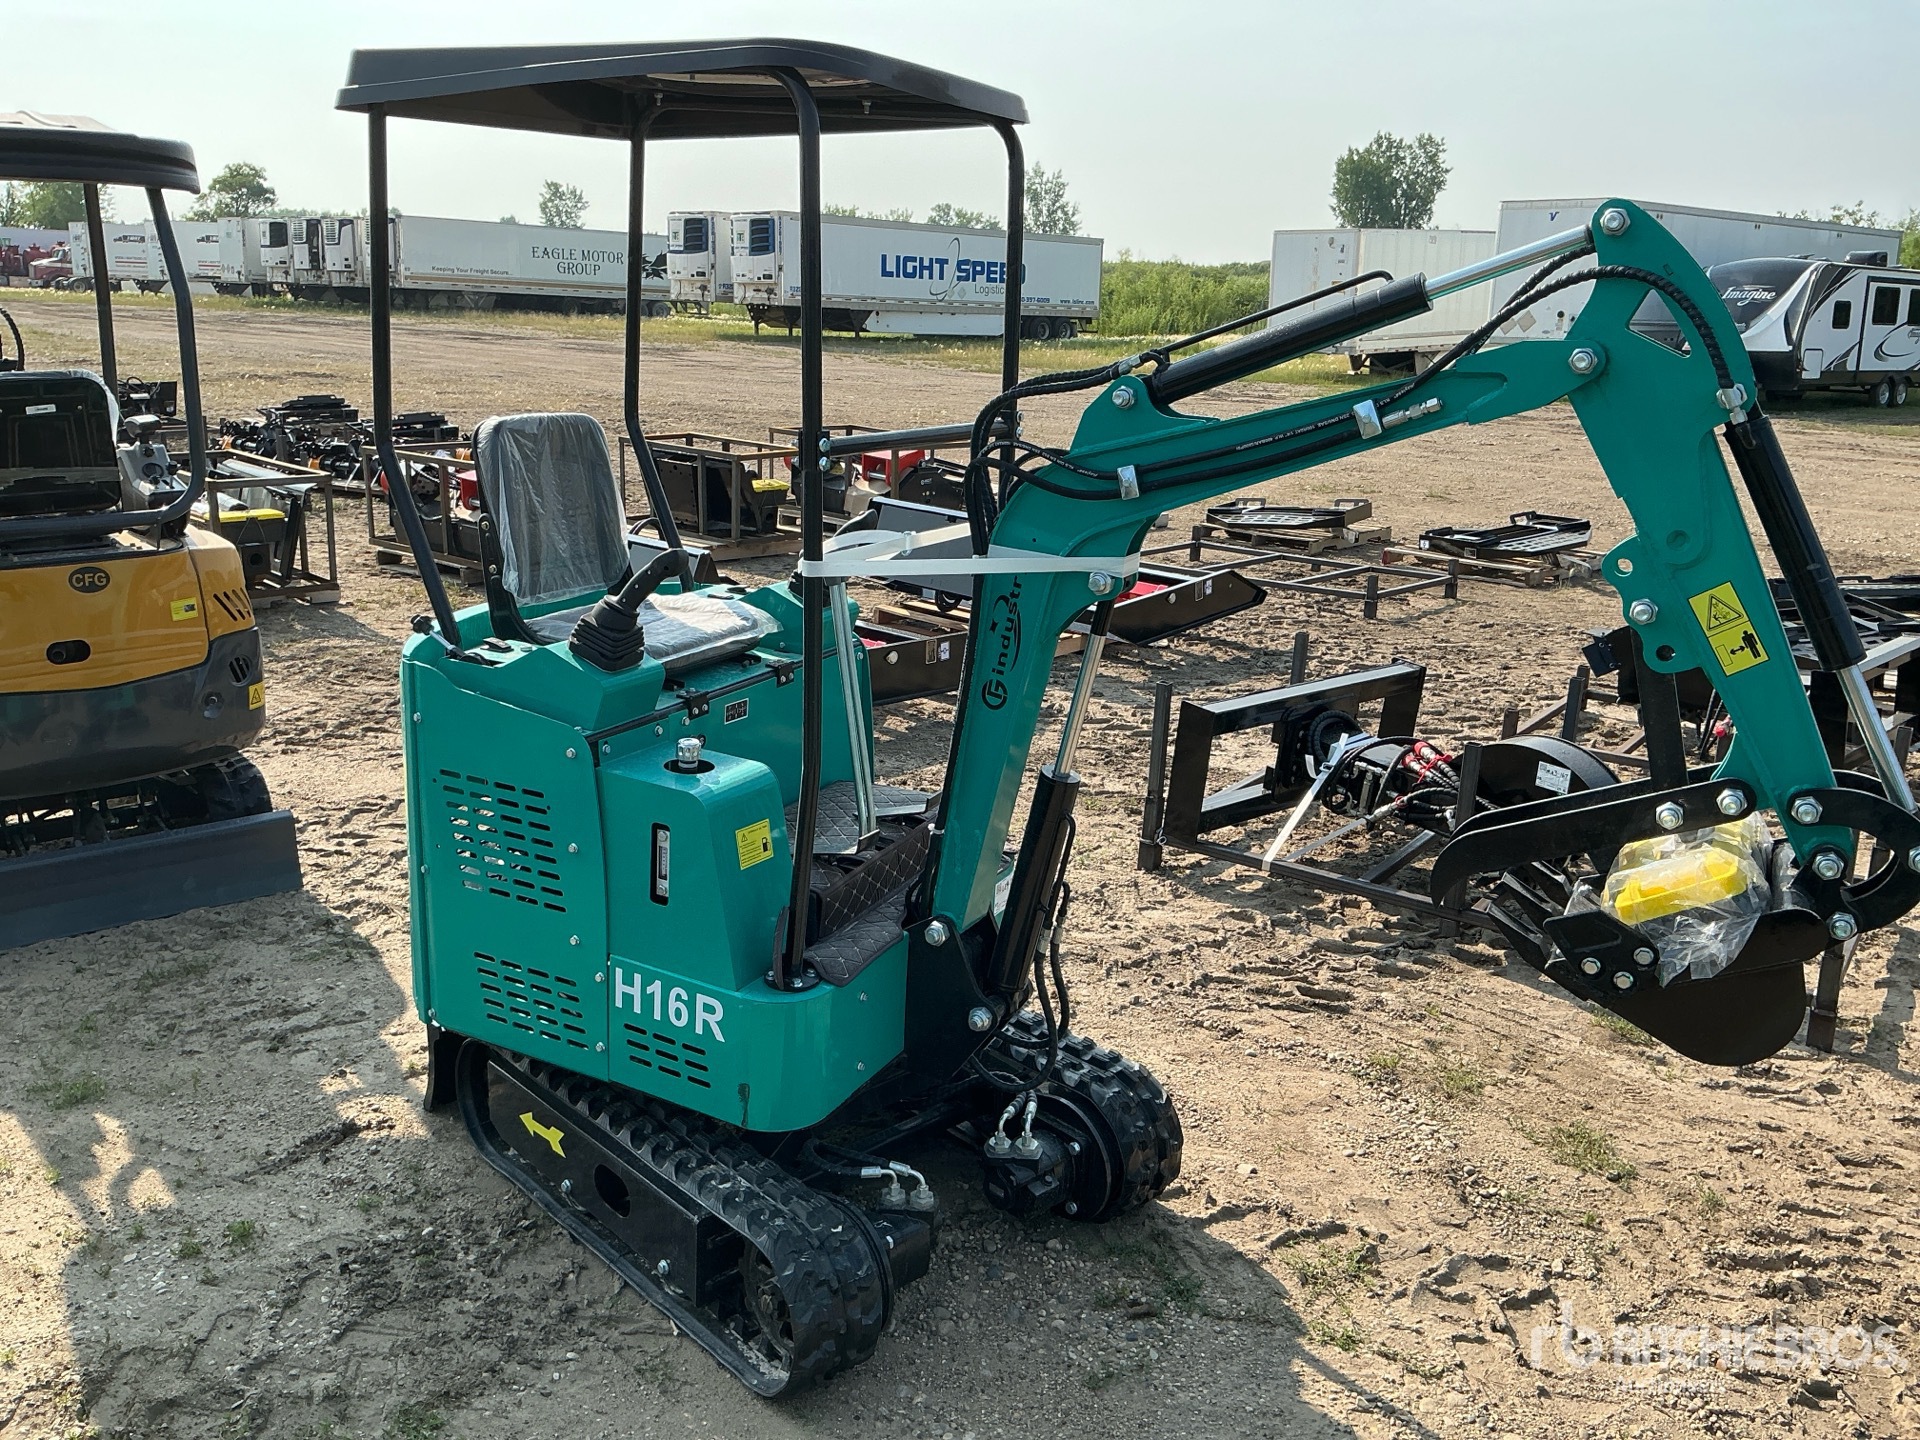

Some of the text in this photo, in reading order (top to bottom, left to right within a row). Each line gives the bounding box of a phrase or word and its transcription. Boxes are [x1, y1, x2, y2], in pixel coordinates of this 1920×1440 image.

[532, 246, 624, 265] EAGLE MOTOR
[431, 265, 455, 274] Keeping
[556, 261, 601, 276] GROUP
[880, 253, 949, 280] LIGHT
[974, 283, 1006, 296] Logistic
[1721, 285, 1778, 306] Imagine
[71, 571, 107, 588] CFG
[615, 966, 726, 1043] H16R
